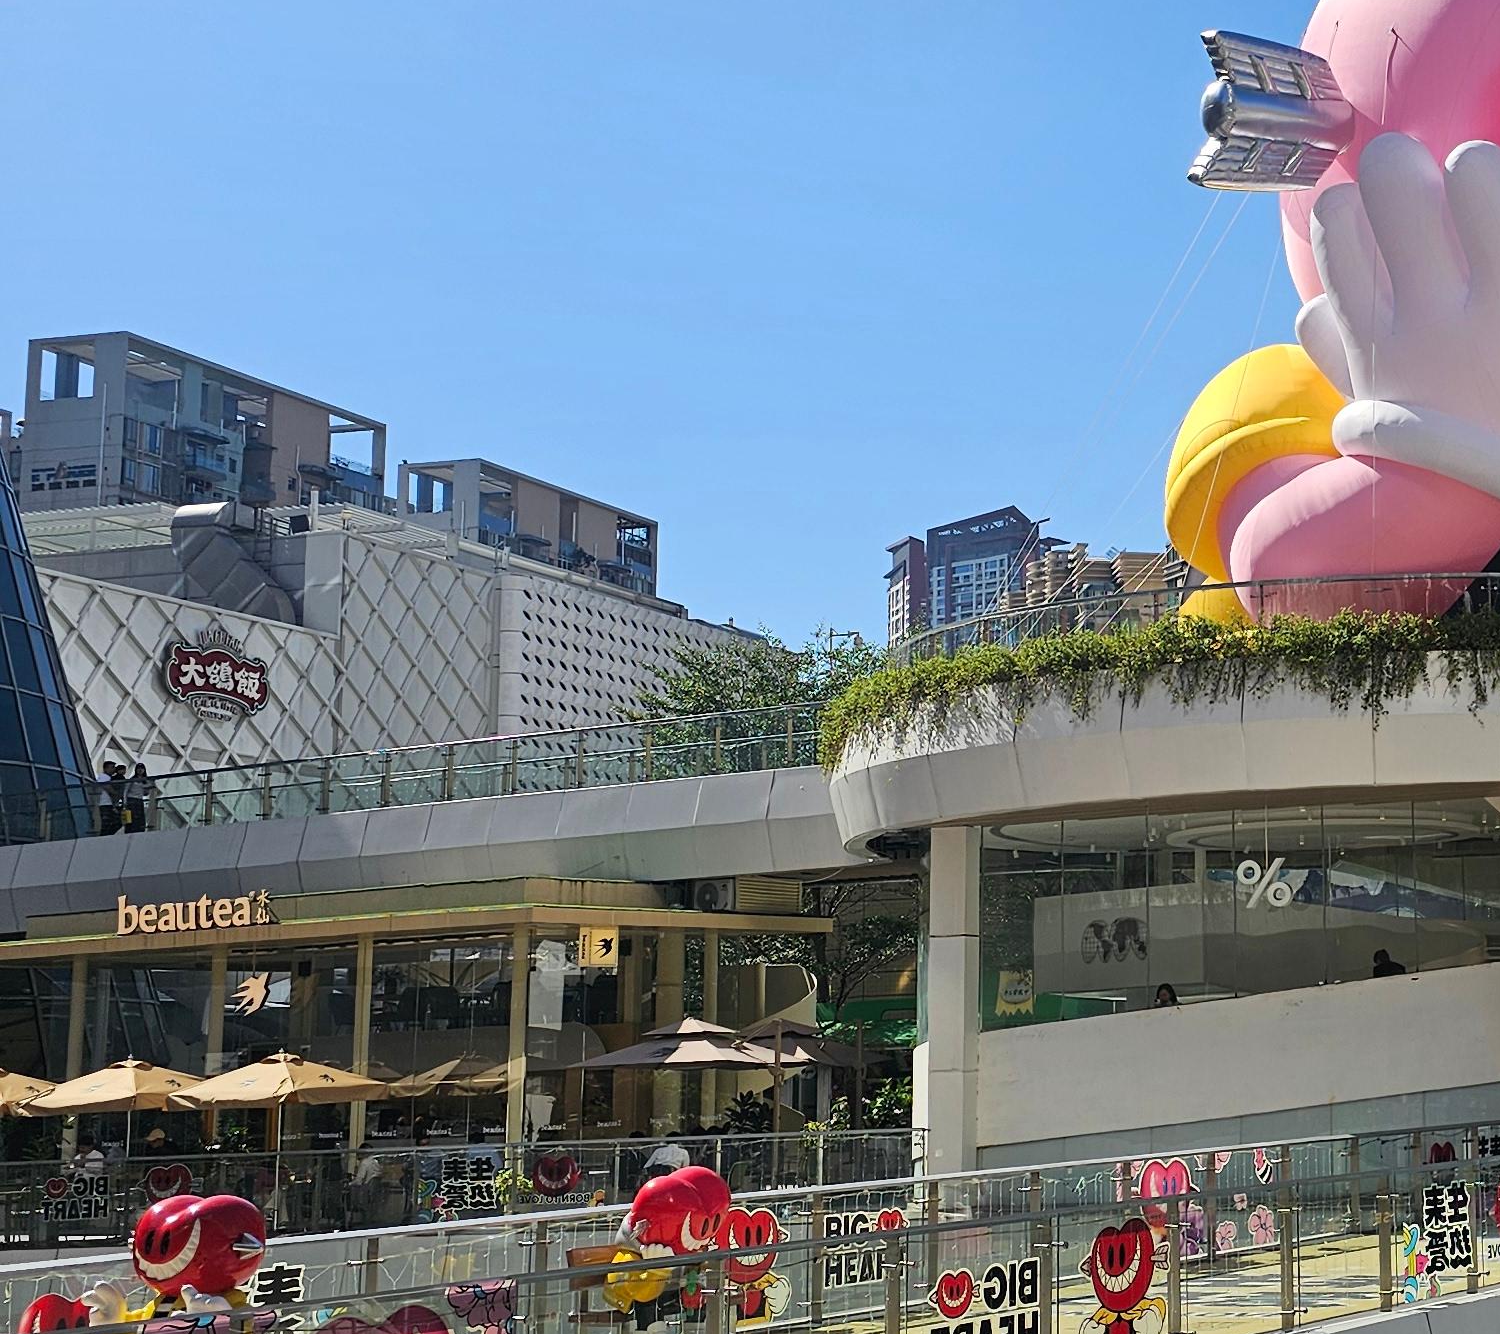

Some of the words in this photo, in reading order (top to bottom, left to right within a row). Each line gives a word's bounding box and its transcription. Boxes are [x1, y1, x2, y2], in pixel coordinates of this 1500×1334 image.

[117, 893, 251, 935] beautea
[256, 888, 271, 925] 水仙
[825, 1214, 869, 1245] BIG
